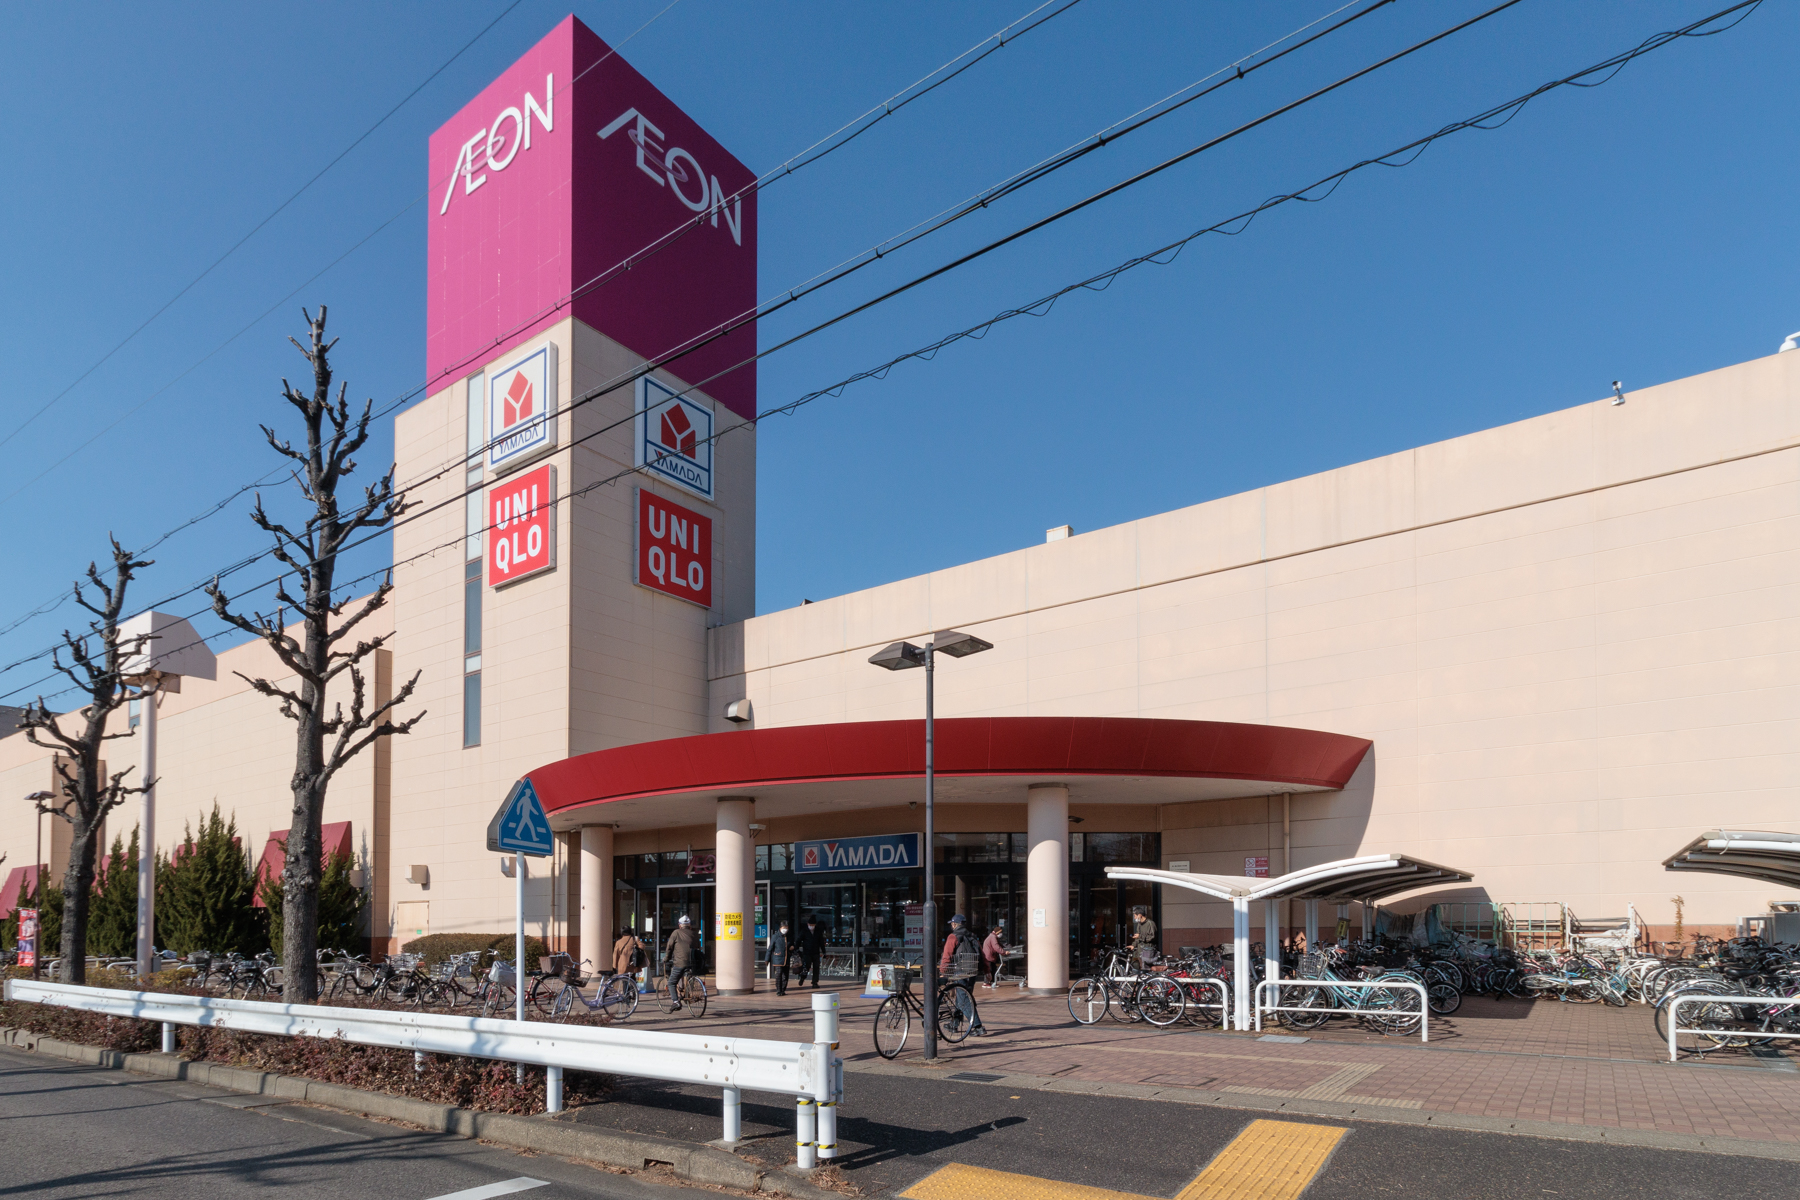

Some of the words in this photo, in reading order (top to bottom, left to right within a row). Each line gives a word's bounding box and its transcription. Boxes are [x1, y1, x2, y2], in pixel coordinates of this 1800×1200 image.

[498, 426, 539, 455] YAMADA
[653, 449, 703, 486] YAMADA
[495, 484, 538, 530] UNI
[648, 504, 700, 555] UNI
[495, 524, 542, 574] QLO
[648, 546, 704, 591] QLO
[823, 843, 909, 867] YAMADA
